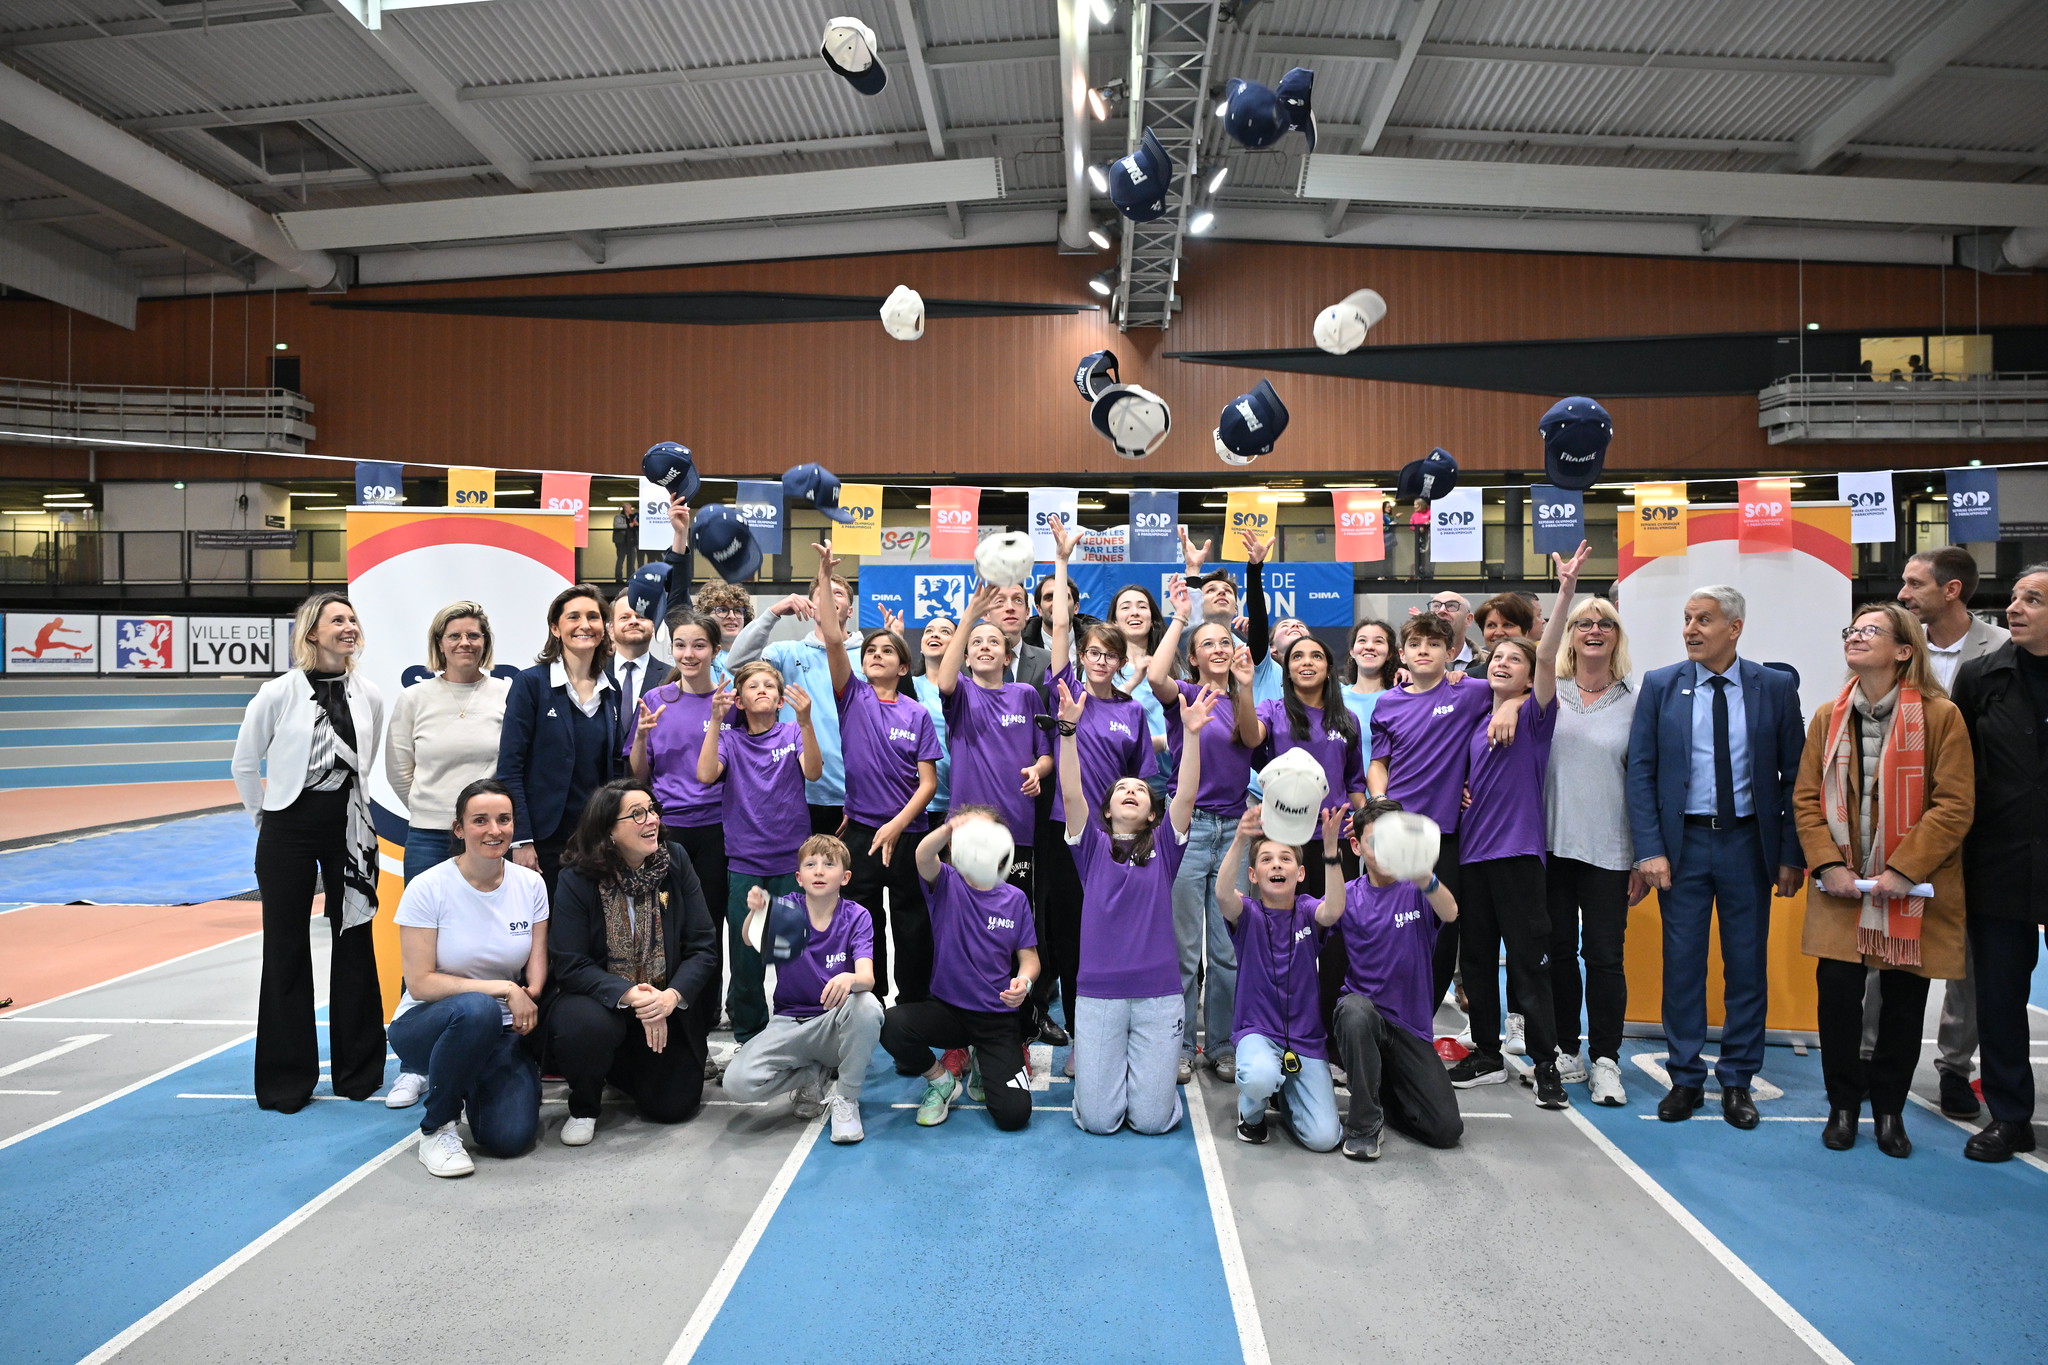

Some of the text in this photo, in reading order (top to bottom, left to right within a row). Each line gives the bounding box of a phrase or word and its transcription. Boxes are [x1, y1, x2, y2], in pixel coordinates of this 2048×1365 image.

[1560, 451, 1597, 462] FRANCE
[363, 486, 396, 500] SOP
[456, 490, 488, 504] SOP
[1847, 492, 1885, 507] SOP
[1953, 491, 1990, 507] SOP
[548, 498, 583, 511] SOP
[647, 502, 671, 515] SO
[742, 504, 777, 519] SOP
[1539, 503, 1576, 519] SOP
[1744, 502, 1783, 518] SOP
[937, 510, 972, 525] SOP
[1136, 513, 1171, 528] SOP
[1233, 512, 1268, 527] SOP
[1341, 512, 1376, 527] SOP
[1438, 511, 1474, 526] SOP
[1641, 506, 1679, 521] SOP
[881, 531, 930, 561] sep
[1083, 537, 1125, 545] JEUNES
[1082, 554, 1124, 562] JEUNES
[1272, 573, 1295, 588] DE
[192, 626, 270, 639] VILLE DE
[193, 642, 270, 665] LYON
[1275, 799, 1309, 815] FRANCE
[1009, 861, 1031, 875] CONVERS
[509, 921, 528, 931] SOP
